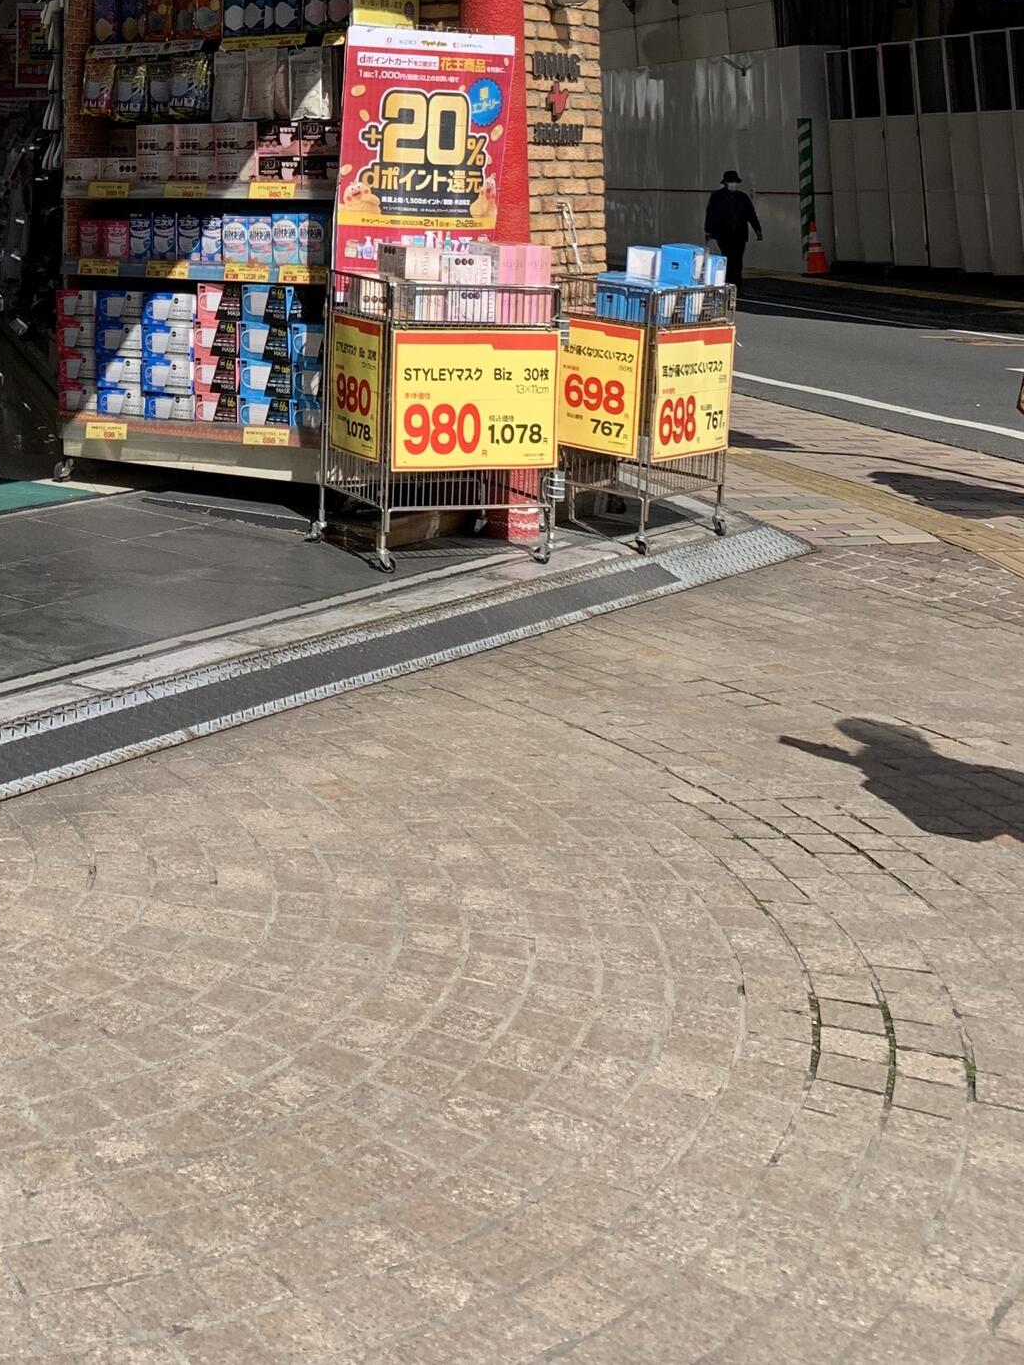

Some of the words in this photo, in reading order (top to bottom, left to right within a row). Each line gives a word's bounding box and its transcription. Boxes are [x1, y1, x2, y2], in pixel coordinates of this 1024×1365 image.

[362, 165, 484, 193] dポイント還元
[563, 344, 635, 364] 耳が痛くなりにくいマスク
[403, 367, 483, 382] STYLEYマスク
[494, 366, 513, 381] Biz
[523, 367, 550, 382] 30枚
[662, 359, 723, 378] 耳が痛くなりにくいマスク
[337, 372, 372, 417] 980
[564, 373, 625, 415] 698
[403, 402, 481, 456] 980
[590, 417, 625, 439] 767
[659, 394, 697, 447] 698
[705, 409, 724, 431] 767
[488, 423, 542, 446] 1,078
